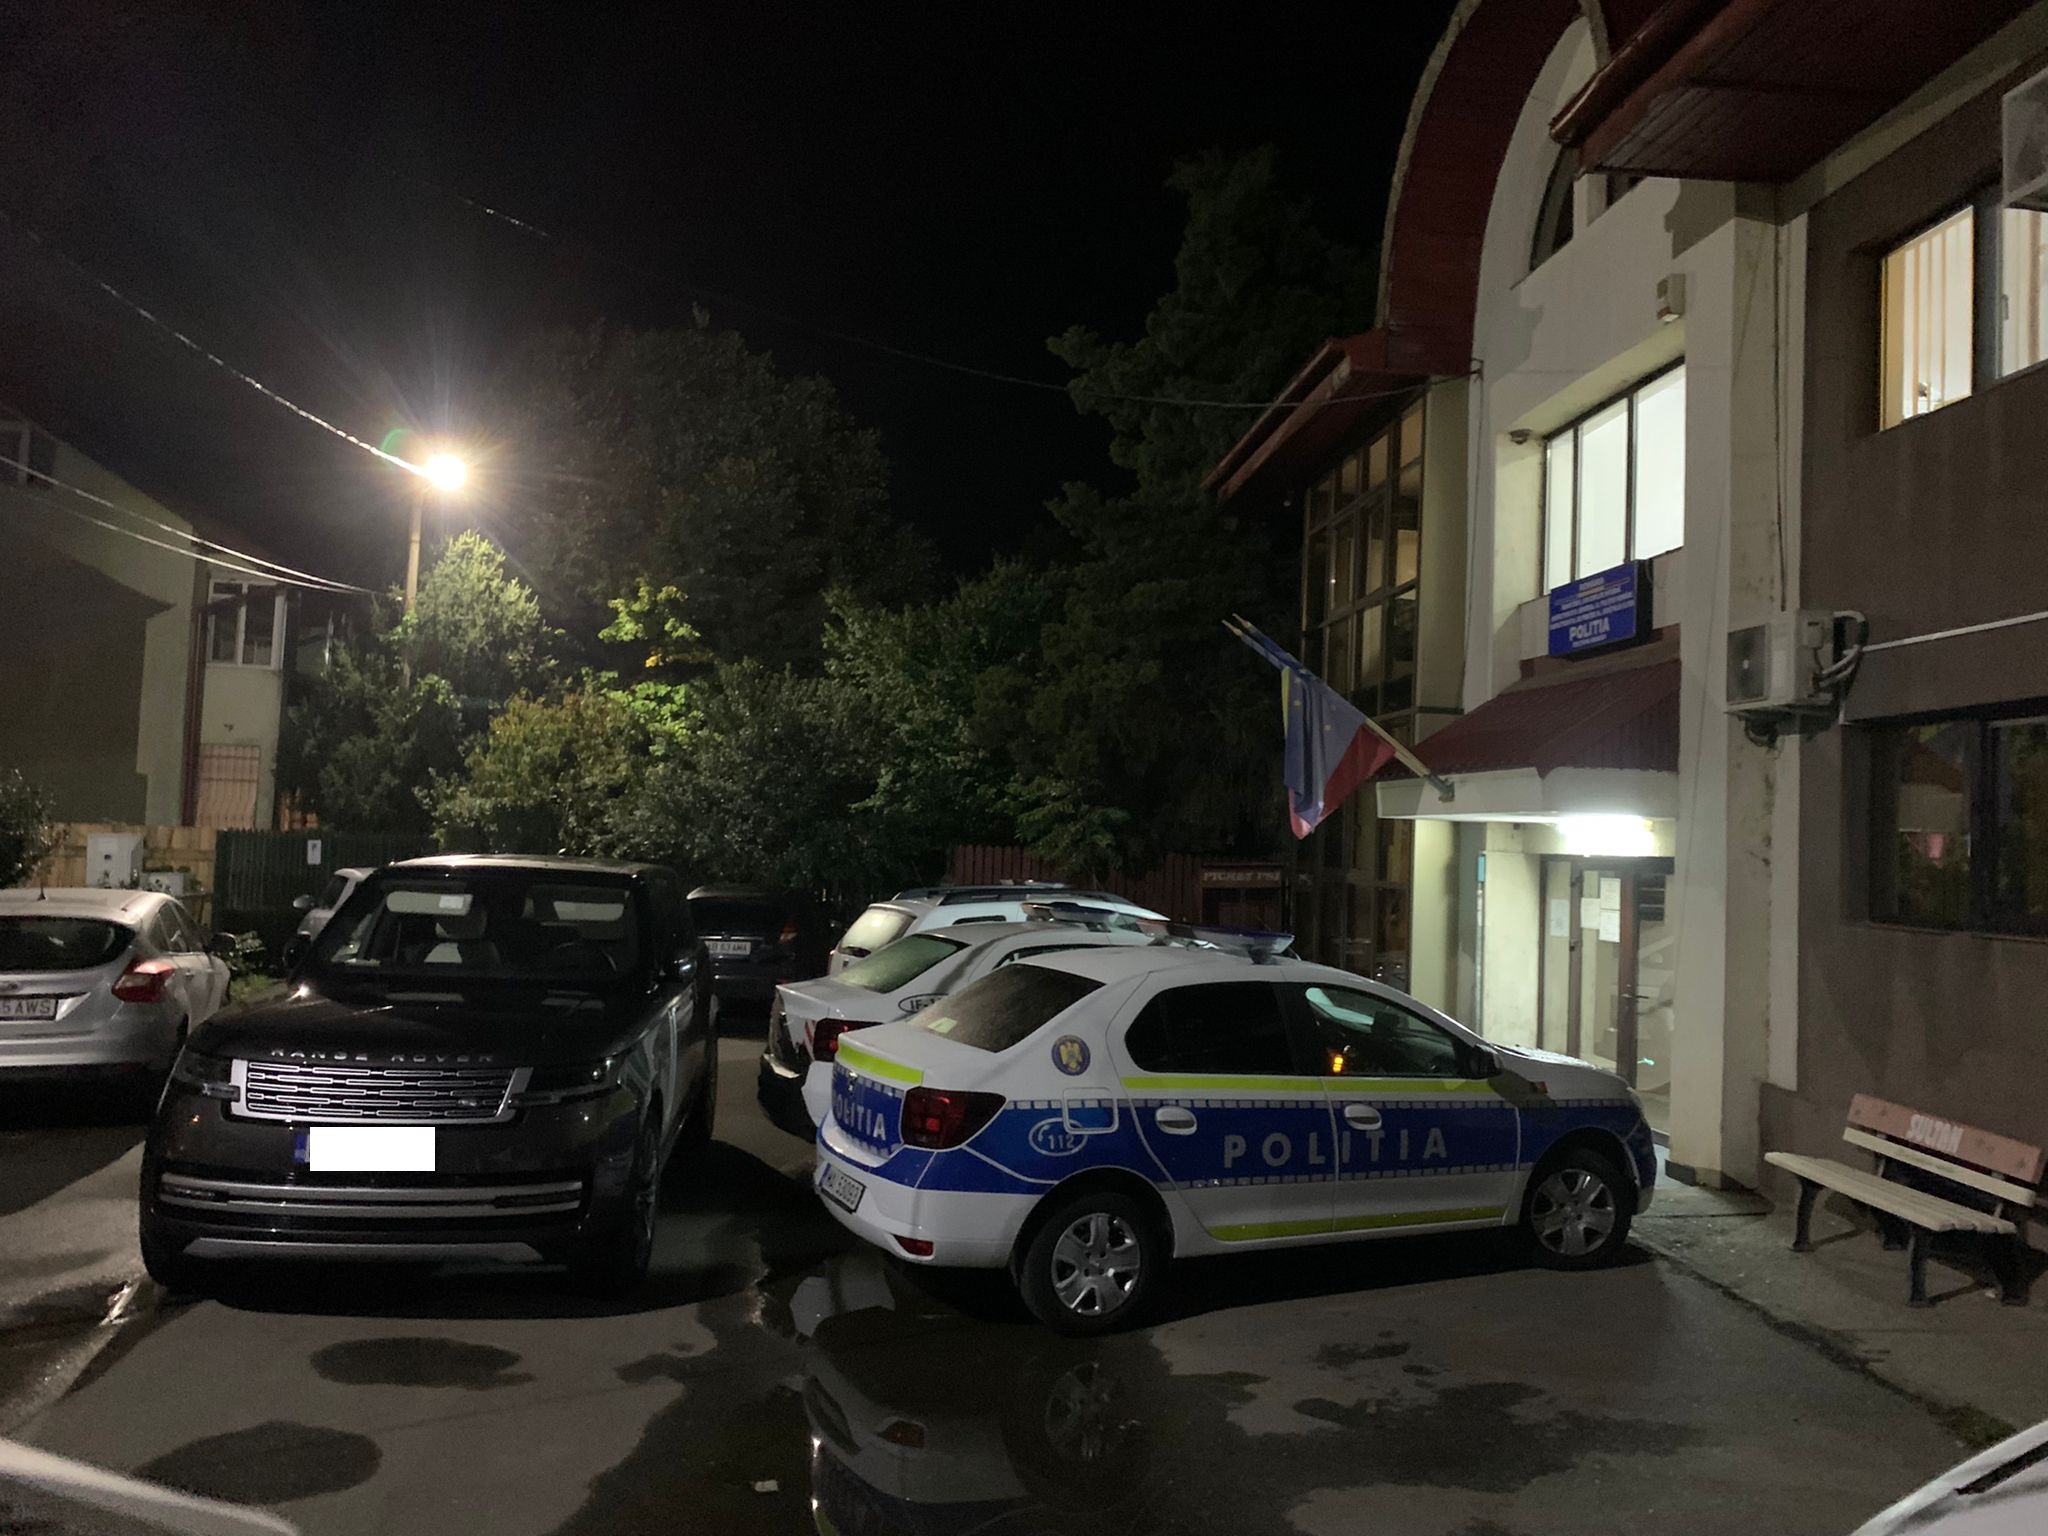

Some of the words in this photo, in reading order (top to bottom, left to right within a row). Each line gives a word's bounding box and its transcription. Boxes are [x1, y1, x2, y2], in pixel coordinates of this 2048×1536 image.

[14, 999, 51, 1015] AWS
[271, 1049, 369, 1062] RANGE
[391, 1055, 493, 1064] ROVER
[1048, 1133, 1076, 1150] 112
[1223, 1127, 1448, 1169] POLITIA
